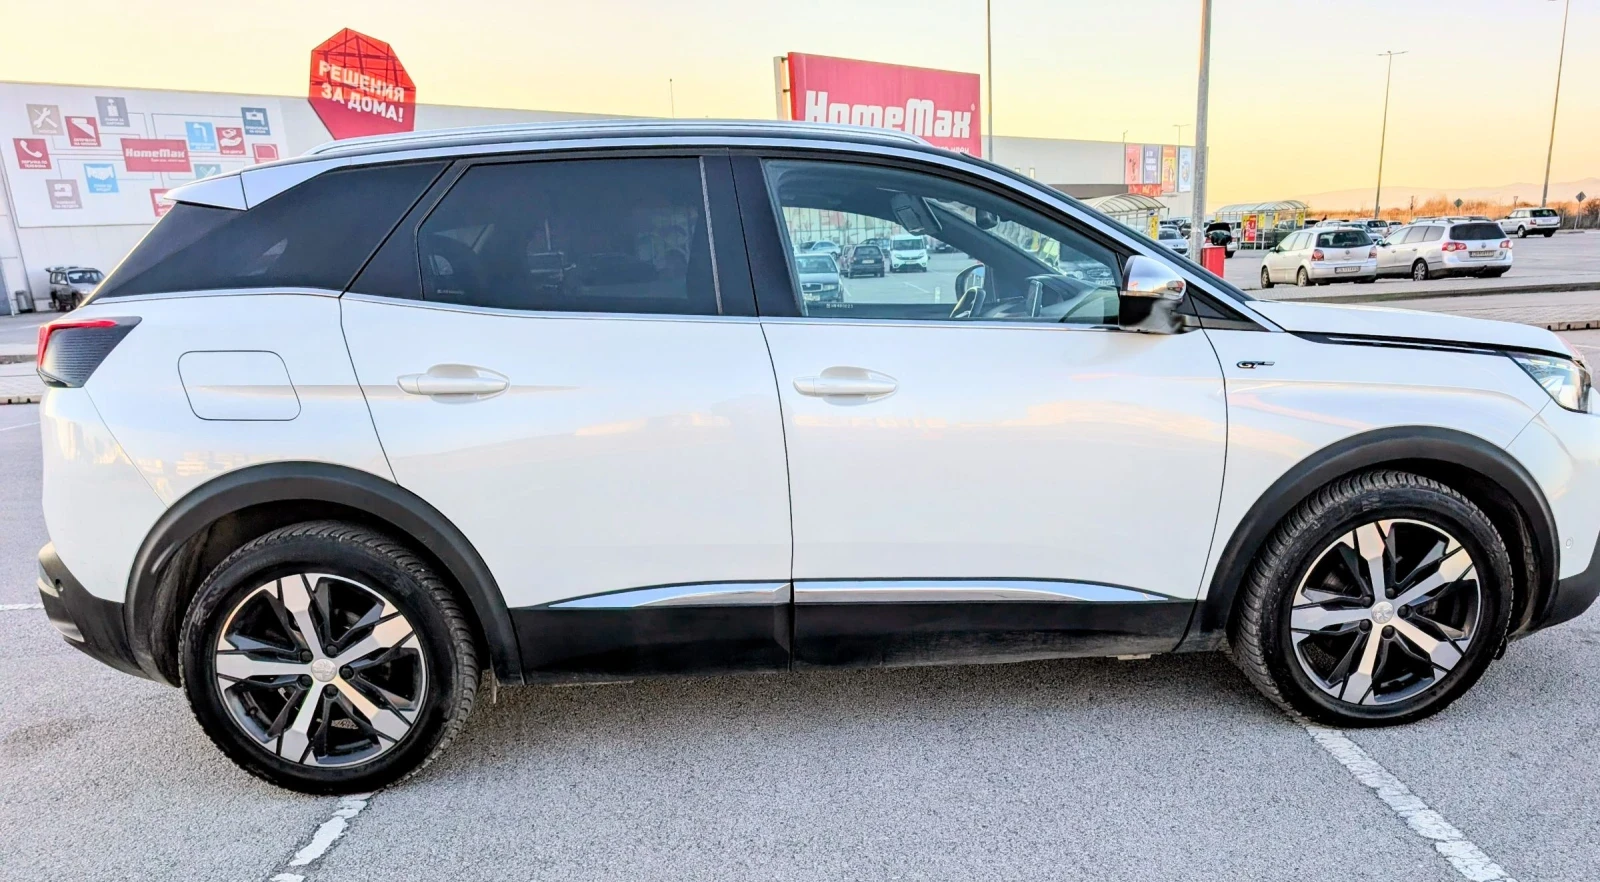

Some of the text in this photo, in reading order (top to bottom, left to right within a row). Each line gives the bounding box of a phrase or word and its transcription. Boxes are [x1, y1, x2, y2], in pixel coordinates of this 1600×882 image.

[319, 60, 405, 103] РЕШЕНИЯ
[321, 83, 404, 123] ЗА ДОМА!
[805, 90, 972, 139] HomeMax
[125, 147, 186, 158] HomeMax
[1236, 360, 1276, 370] GT
